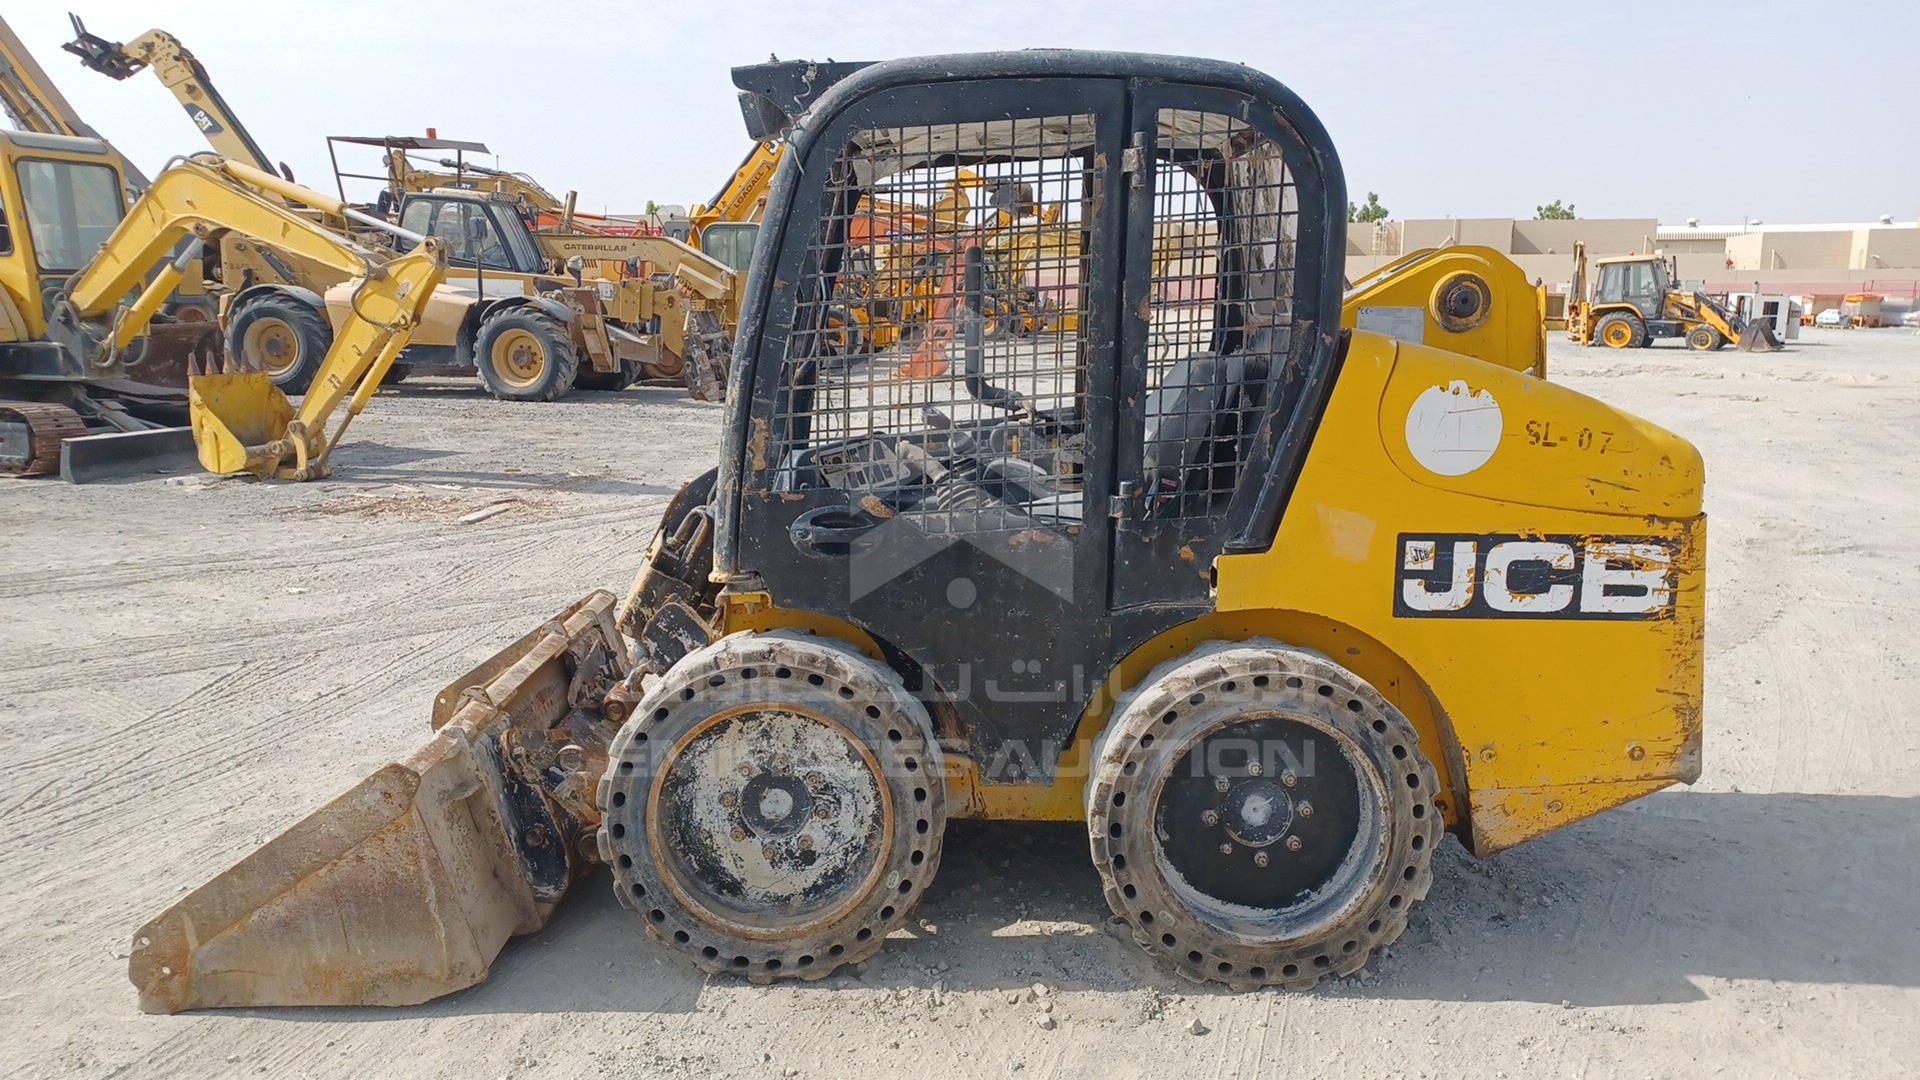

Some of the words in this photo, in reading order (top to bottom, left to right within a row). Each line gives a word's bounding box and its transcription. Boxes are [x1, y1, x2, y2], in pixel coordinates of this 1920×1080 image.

[193, 110, 213, 131] CAT
[733, 170, 765, 209] LOADALL
[563, 243, 627, 252] CATERPILLAR
[1412, 548, 1430, 562] JCB
[1401, 539, 1674, 614] JCB
